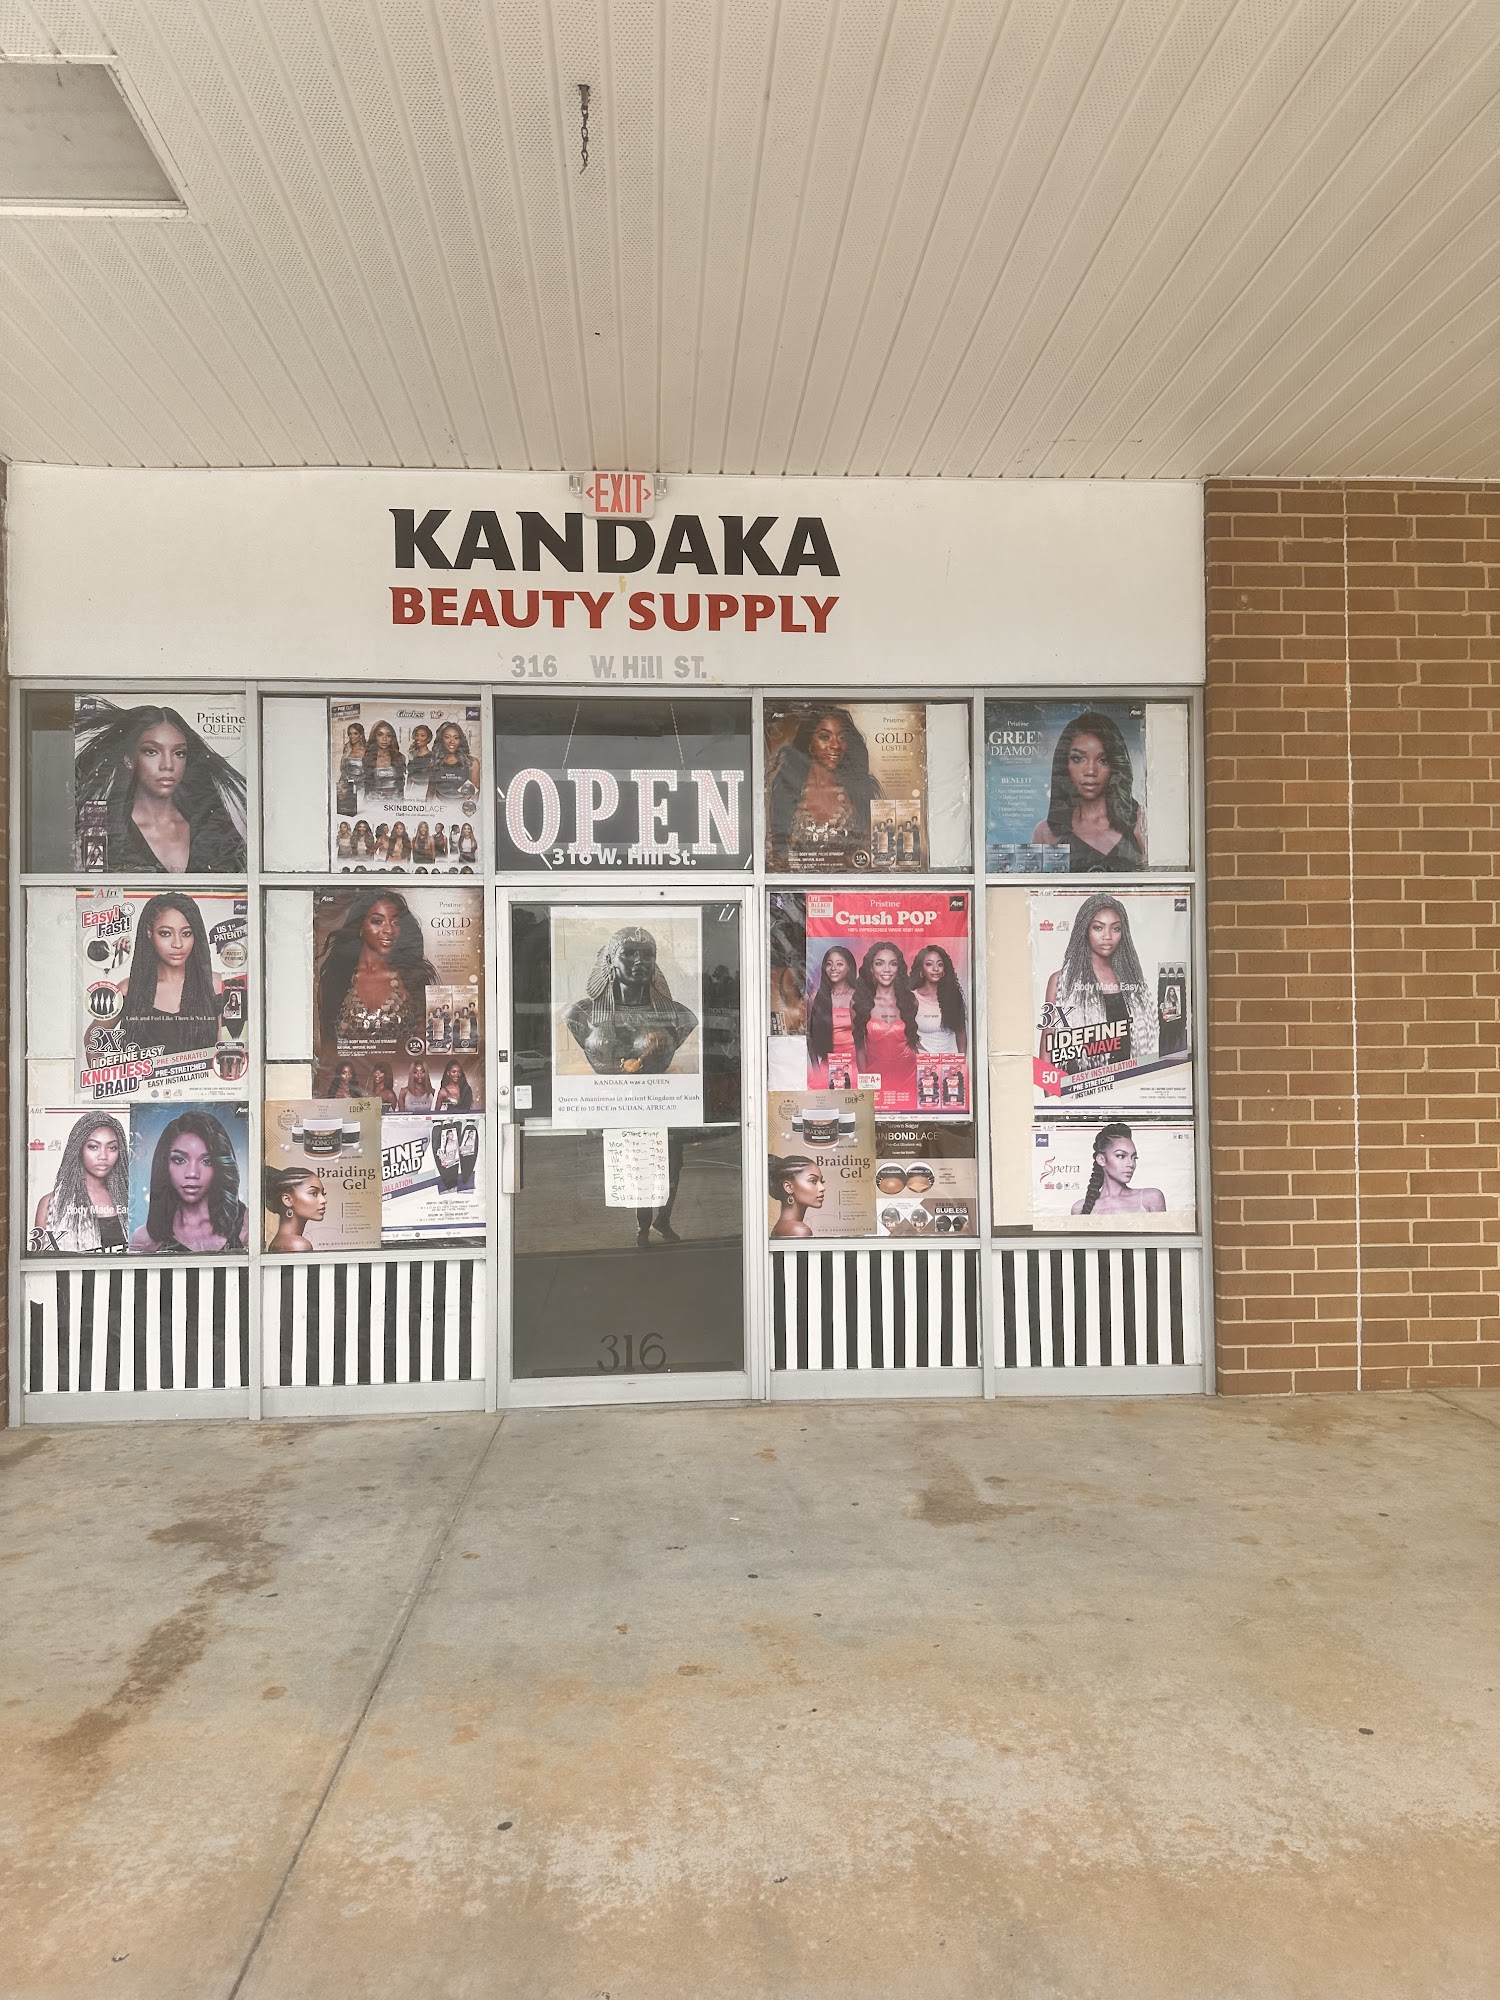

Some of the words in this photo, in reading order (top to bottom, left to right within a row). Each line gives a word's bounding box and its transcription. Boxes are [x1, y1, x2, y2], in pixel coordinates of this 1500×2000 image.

[595, 473, 643, 513] EXIT
[389, 508, 841, 577] KANDAKA
[389, 586, 615, 629] BEAUTY
[629, 591, 840, 633] SUPPLY
[511, 655, 558, 678] 316
[589, 655, 617, 679] W.
[623, 655, 663, 680] Hill
[674, 655, 707, 679] ST.
[197, 712, 246, 724] Pristine
[203, 723, 242, 735] QUEEN
[875, 732, 914, 744] GOLD
[506, 768, 745, 855] OPEN
[669, 848, 697, 866] St.
[869, 899, 901, 908] Pristine
[84, 906, 119, 927] Easy!
[430, 917, 471, 929] GOLD
[836, 910, 893, 925] Crush
[896, 910, 938, 925] POP
[98, 917, 130, 937] Fast!
[216, 925, 227, 934] US
[437, 929, 465, 937] LUSTER
[1074, 981, 1095, 994] Body
[1096, 982, 1118, 991] Made
[1120, 982, 1140, 993] Easy
[1037, 1002, 1075, 1030] 3X
[87, 1027, 125, 1052] 3X
[1046, 1034, 1053, 1051] I
[1058, 1019, 1128, 1049] DEFINE
[98, 1051, 138, 1067] DEFINE
[140, 1046, 164, 1059] EASY
[156, 1050, 208, 1065] PRE-SEPARATED
[1052, 1044, 1084, 1063] EASY
[1085, 1037, 1121, 1056] WAVE
[82, 1060, 151, 1086] KNOTLESS
[155, 1062, 207, 1078] PRE-STRETCHED
[1072, 1072, 1089, 1083] EASY
[1091, 1059, 1138, 1077] INSTALLATION
[95, 1076, 138, 1098] BRAID
[147, 1079, 164, 1088] EASY
[166, 1071, 209, 1085] INSTALLATION
[647, 1078, 670, 1086] QUEEN
[870, 1075, 881, 1084] A+
[1073, 1083, 1084, 1092] PRE
[1085, 1075, 1115, 1088] STRETCHED
[647, 1094, 675, 1102] Kingdom
[1075, 1089, 1097, 1099] INSTANT
[1097, 1084, 1114, 1094] STYLE
[904, 1122, 920, 1130] Sugar
[875, 1131, 940, 1141] INBONDLACE
[381, 1156, 421, 1180] BRAID
[816, 1155, 871, 1169] Braiding
[316, 1165, 376, 1180] Braiding
[840, 1167, 863, 1178] Gel
[342, 1178, 367, 1190] Gel
[67, 1204, 88, 1218] Body
[90, 1205, 114, 1214] Made
[29, 1227, 67, 1251] 3X
[596, 1332, 667, 1373] 316
